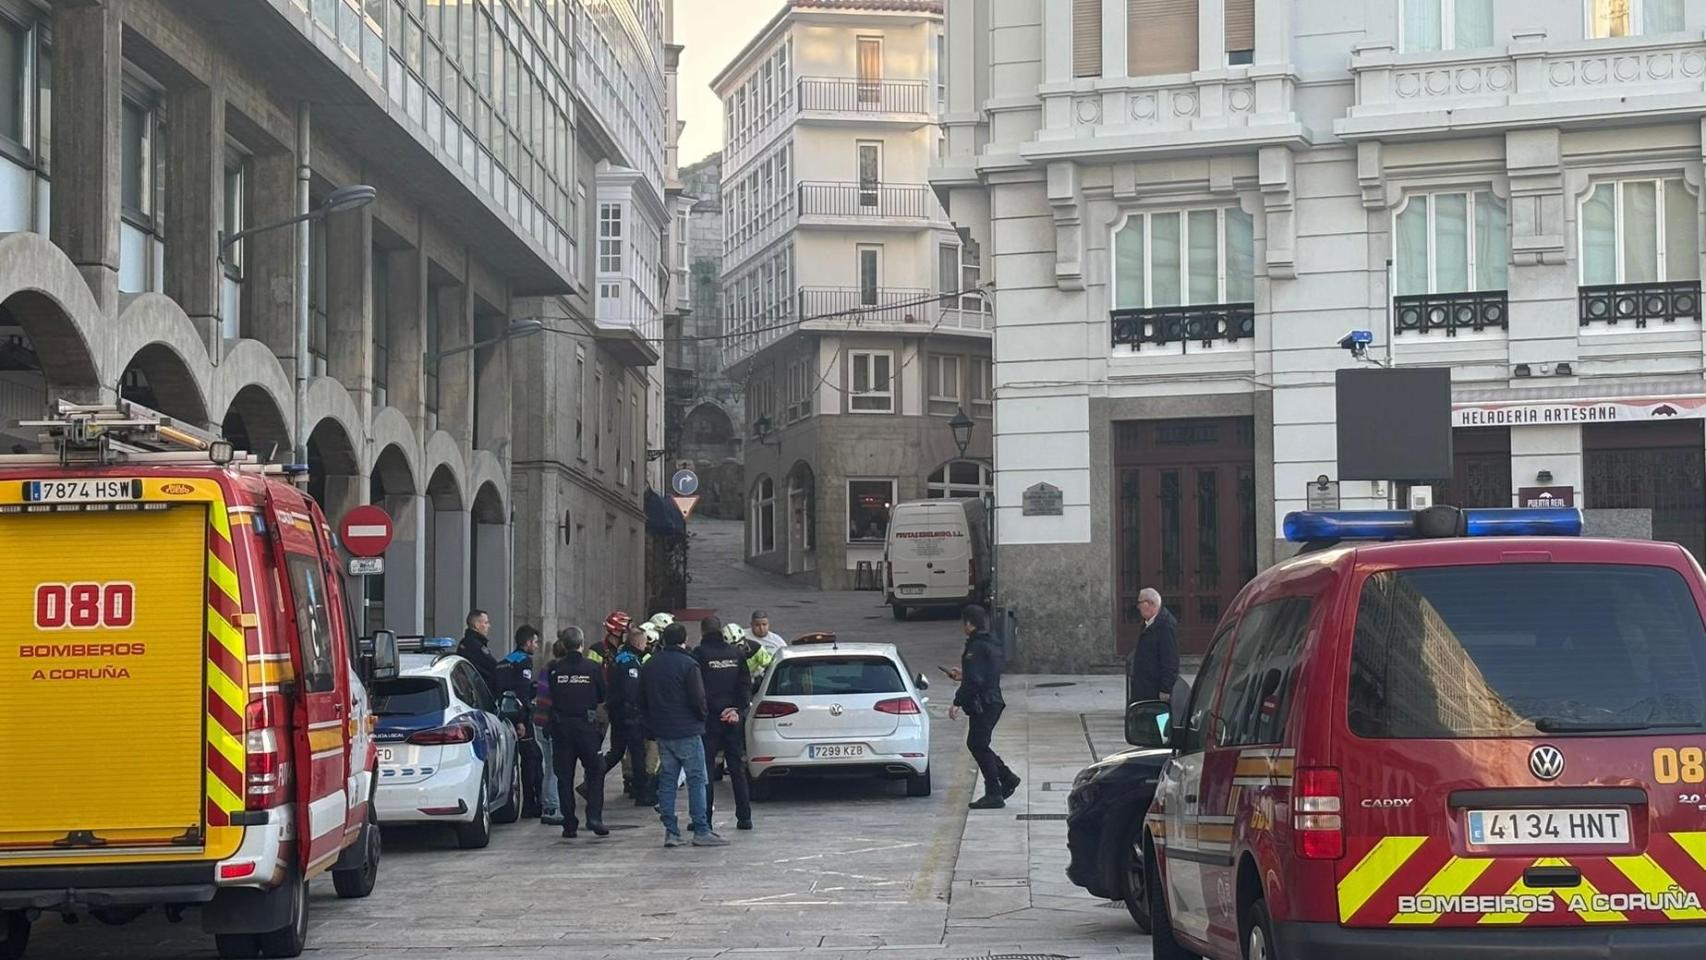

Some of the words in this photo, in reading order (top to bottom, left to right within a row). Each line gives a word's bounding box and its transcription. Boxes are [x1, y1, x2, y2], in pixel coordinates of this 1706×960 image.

[1462, 408, 1537, 424] HELADERÍA
[1544, 406, 1617, 422] ARTESANA
[44, 482, 89, 499] 7874
[95, 481, 130, 498] HSW
[34, 582, 135, 630] 080
[19, 643, 145, 658] BOMBEROS
[32, 669, 46, 680] A
[49, 665, 130, 680] CORUÑA
[815, 746, 841, 757] 7299
[843, 745, 863, 756] KZB
[1653, 747, 1706, 784] 08
[1361, 798, 1413, 808] CADDY
[1490, 813, 1560, 839] 4134
[1569, 813, 1620, 839] HNT
[1398, 894, 1555, 913] BOMBEIROS
[1568, 894, 1588, 912] A
[1592, 884, 1703, 911] CORUÑA
